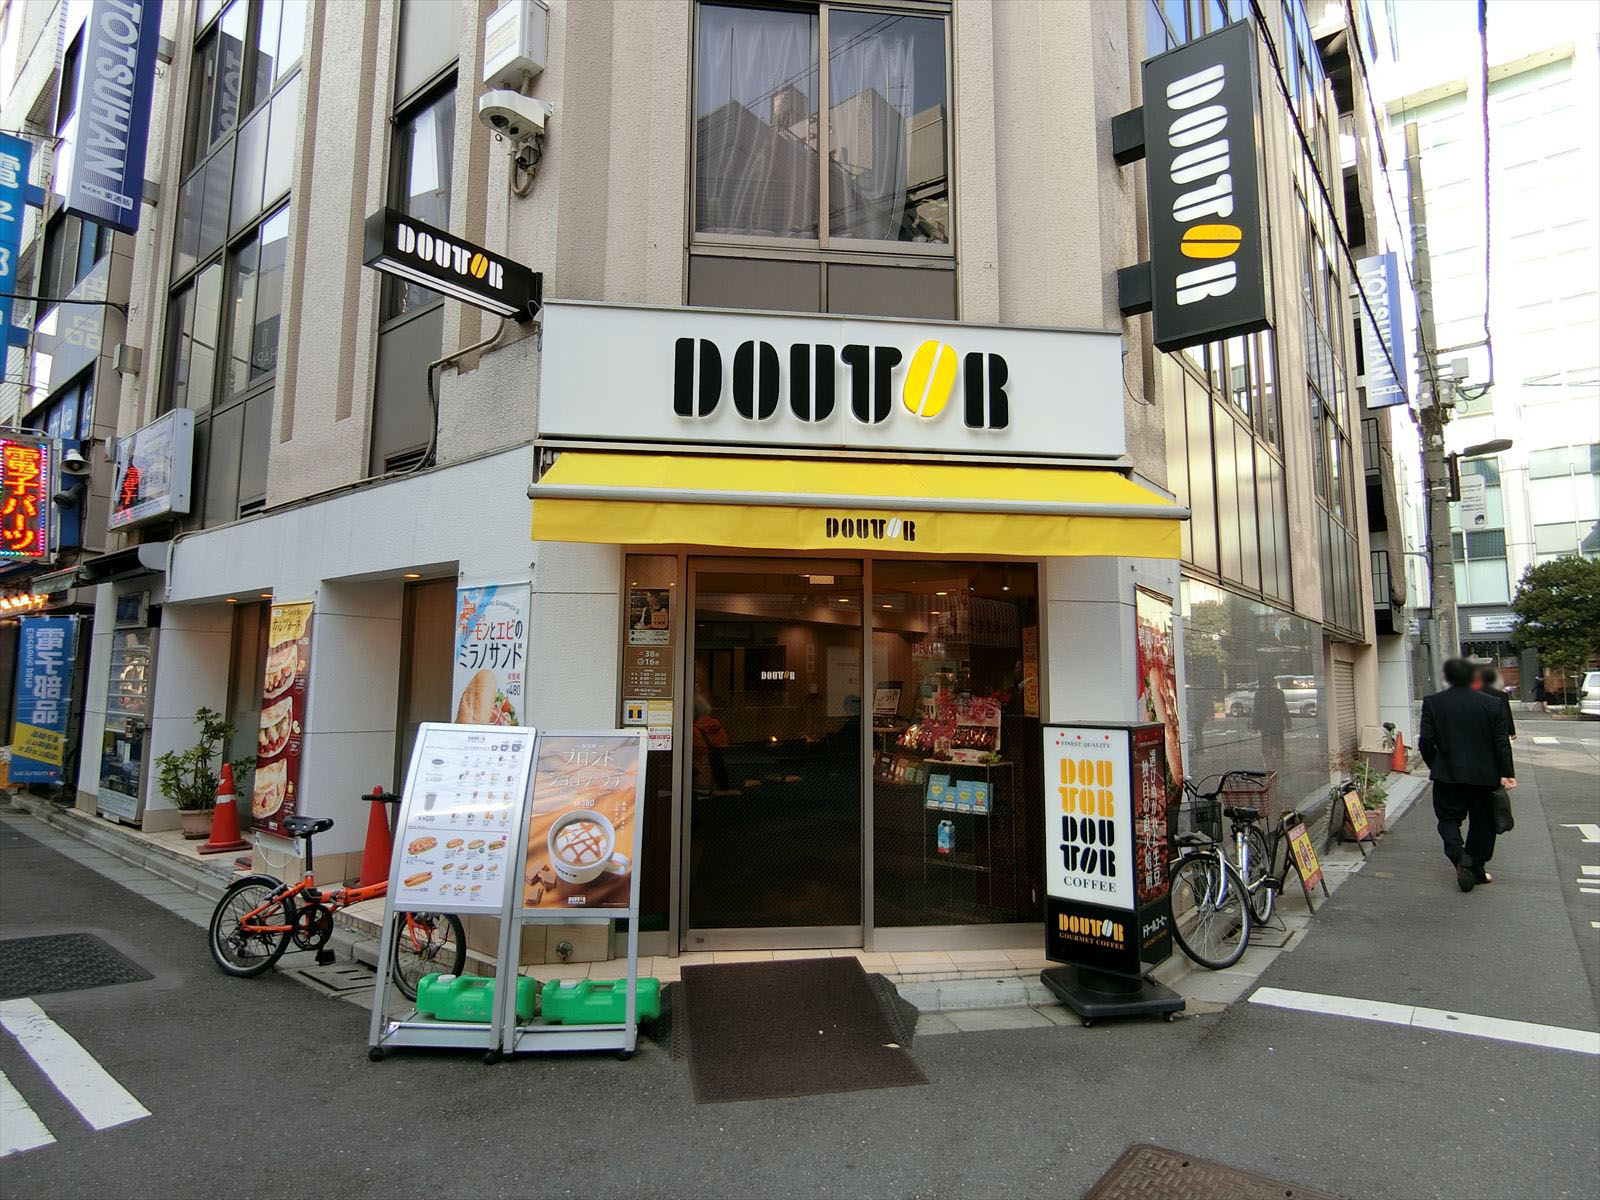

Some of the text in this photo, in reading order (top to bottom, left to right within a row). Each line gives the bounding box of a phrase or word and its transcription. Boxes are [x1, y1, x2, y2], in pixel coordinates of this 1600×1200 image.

[84, 0, 142, 182] TOTSUHAN
[1166, 64, 1243, 306] DOUTOR
[397, 223, 504, 290] DOUTOR
[674, 337, 1009, 430] DOUTOR
[3, 446, 40, 550] 電子パーツ
[826, 517, 915, 542] DOUTOR
[460, 619, 523, 641] サーモンとエビの
[459, 642, 522, 669] ミラノサンド
[761, 670, 795, 680] DOUTOR
[563, 748, 614, 767] ブロンド
[1060, 758, 1113, 788] DOU
[1058, 786, 1114, 817] TOR
[1062, 816, 1115, 847] DOU
[1060, 844, 1116, 877] TOR
[1063, 875, 1117, 893] COFFEE
[1058, 913, 1124, 942] DOUTOR
[1059, 932, 1125, 951] GOURMET COFFEE
